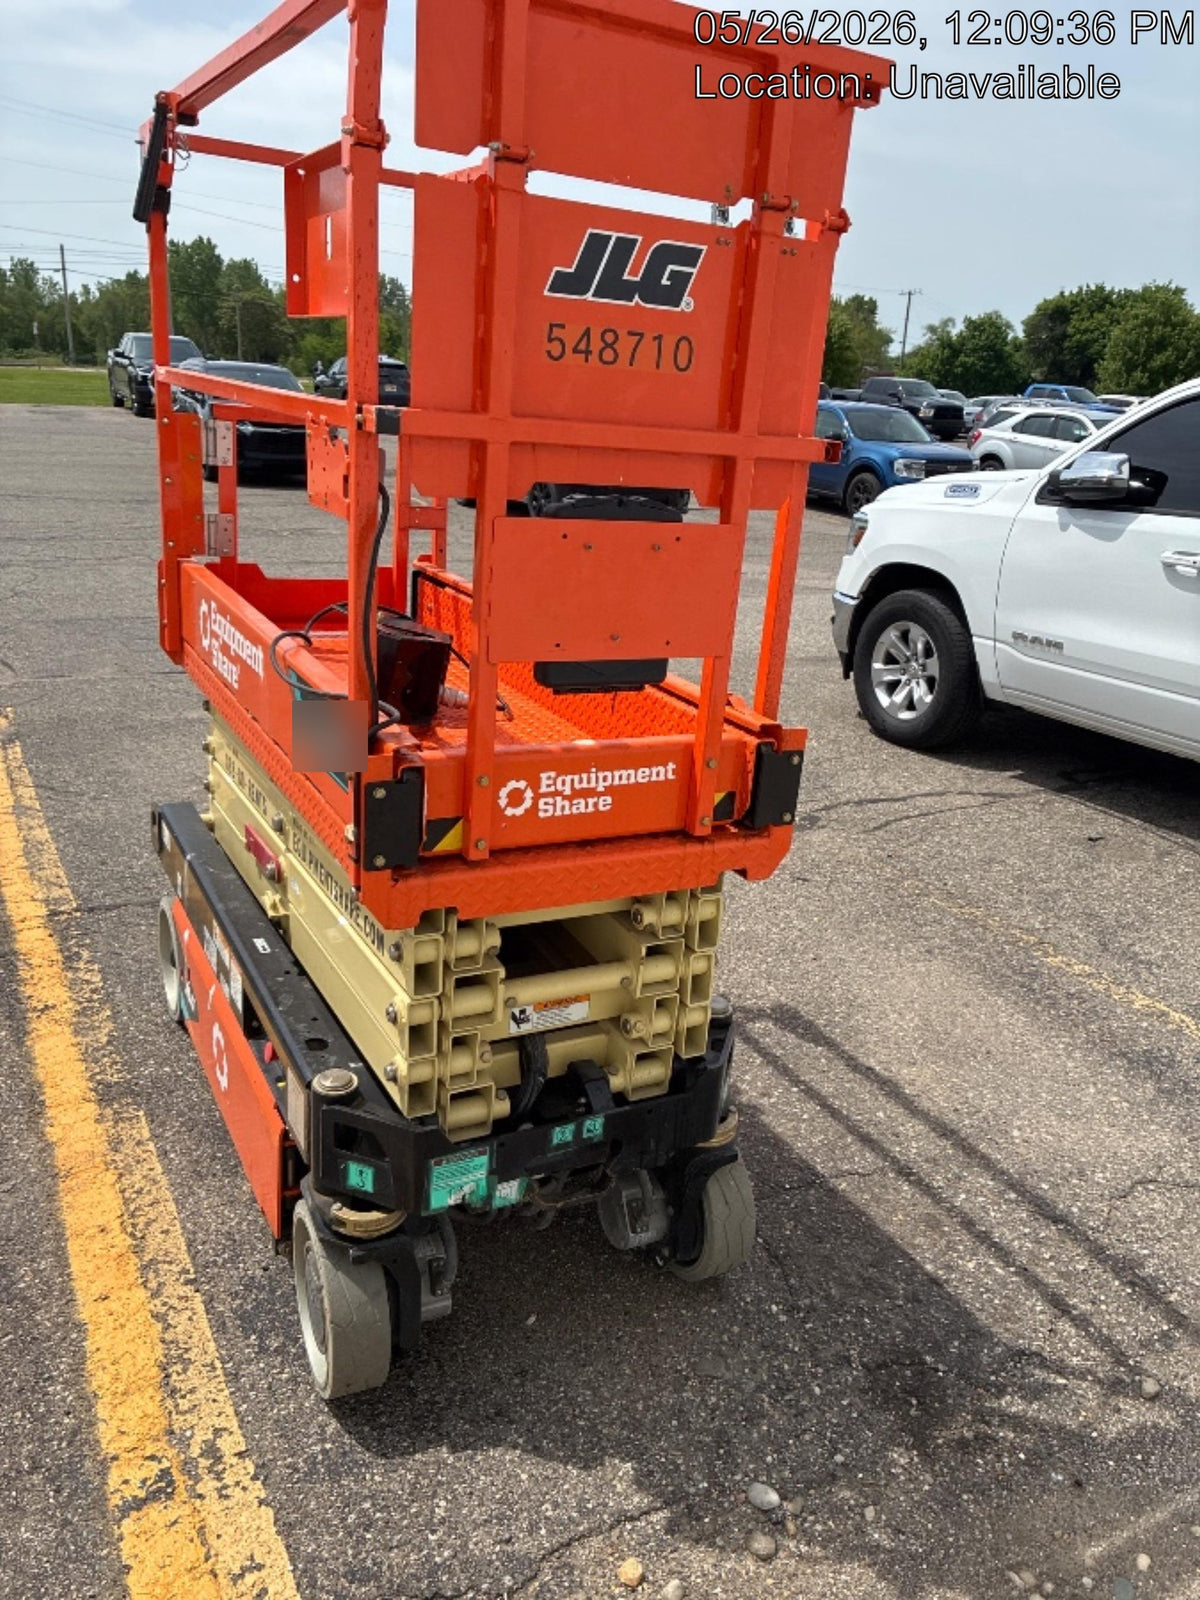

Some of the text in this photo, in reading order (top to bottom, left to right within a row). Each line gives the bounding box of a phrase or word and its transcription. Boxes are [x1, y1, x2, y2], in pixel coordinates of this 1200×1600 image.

[543, 228, 708, 312] JLG
[545, 322, 694, 372] 548710
[210, 599, 264, 682] Equipment
[211, 638, 241, 690] Share
[538, 761, 677, 795] Equipment
[537, 795, 613, 818] Share
